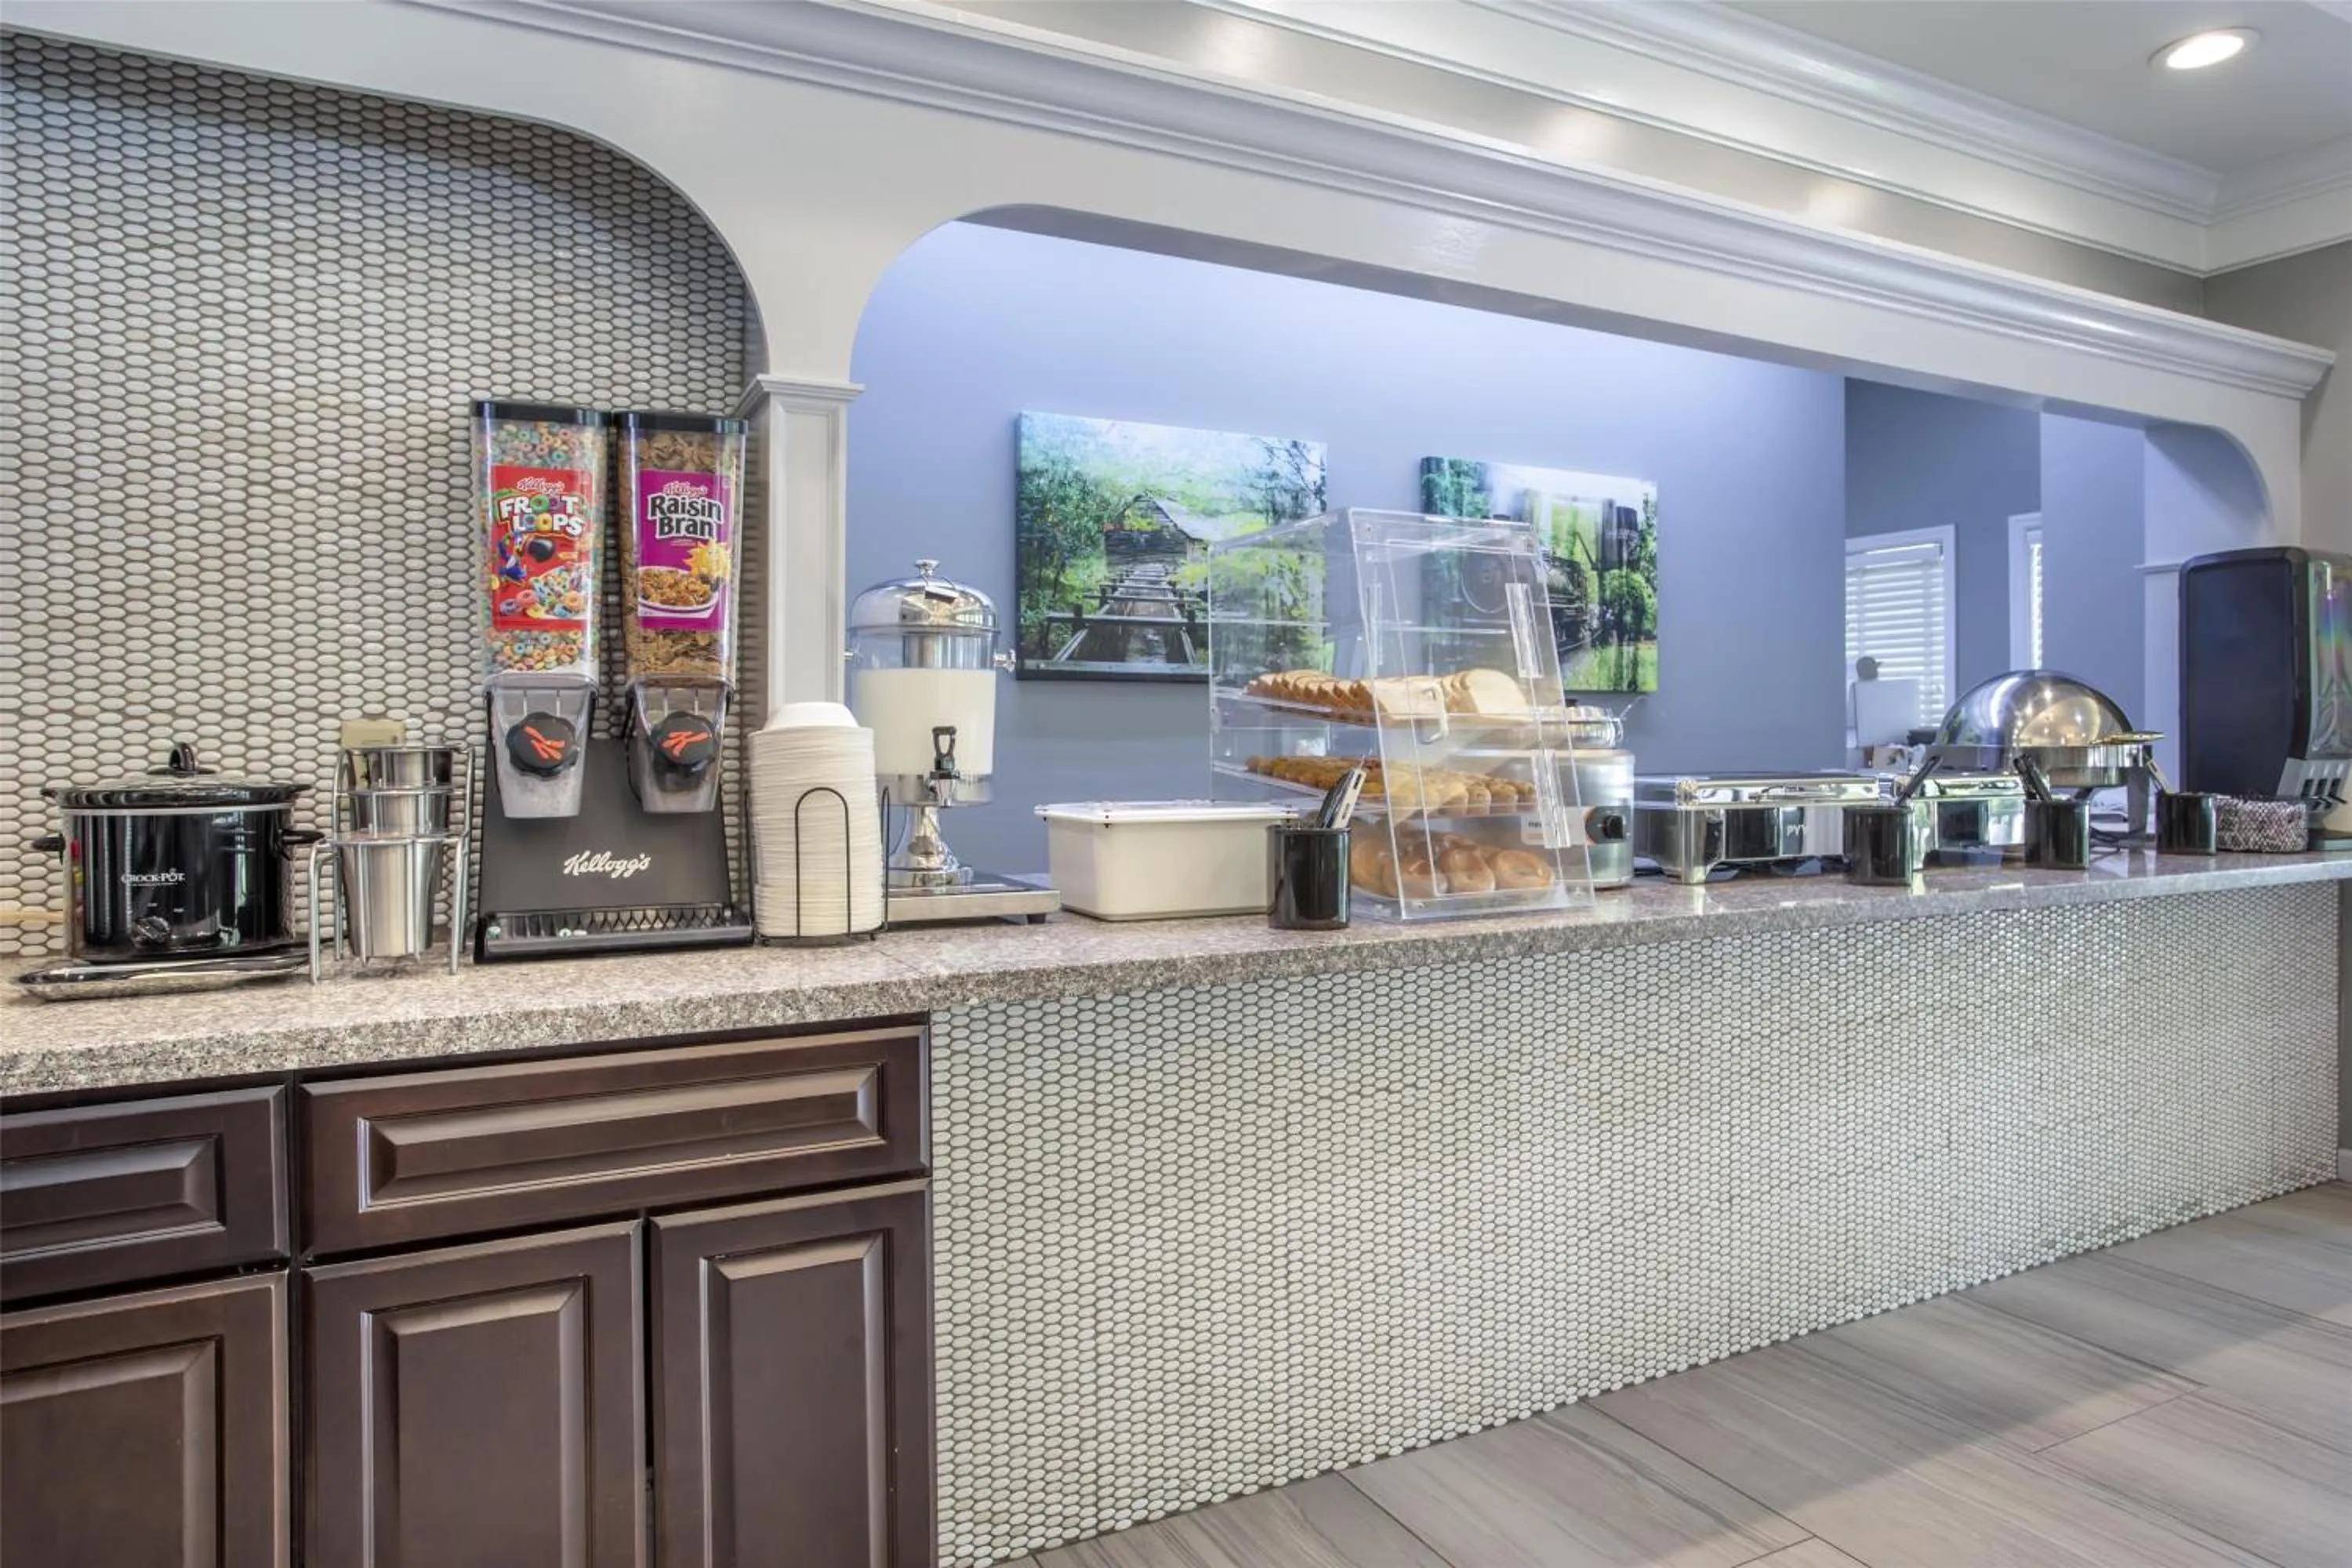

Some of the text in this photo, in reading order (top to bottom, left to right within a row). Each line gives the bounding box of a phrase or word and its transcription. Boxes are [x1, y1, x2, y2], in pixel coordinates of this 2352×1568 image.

[499, 495, 580, 518] FROOT
[649, 494, 723, 523] Raisin
[512, 513, 585, 536] LOOPS
[657, 516, 714, 538] Bran
[564, 850, 651, 878] Kellogg's
